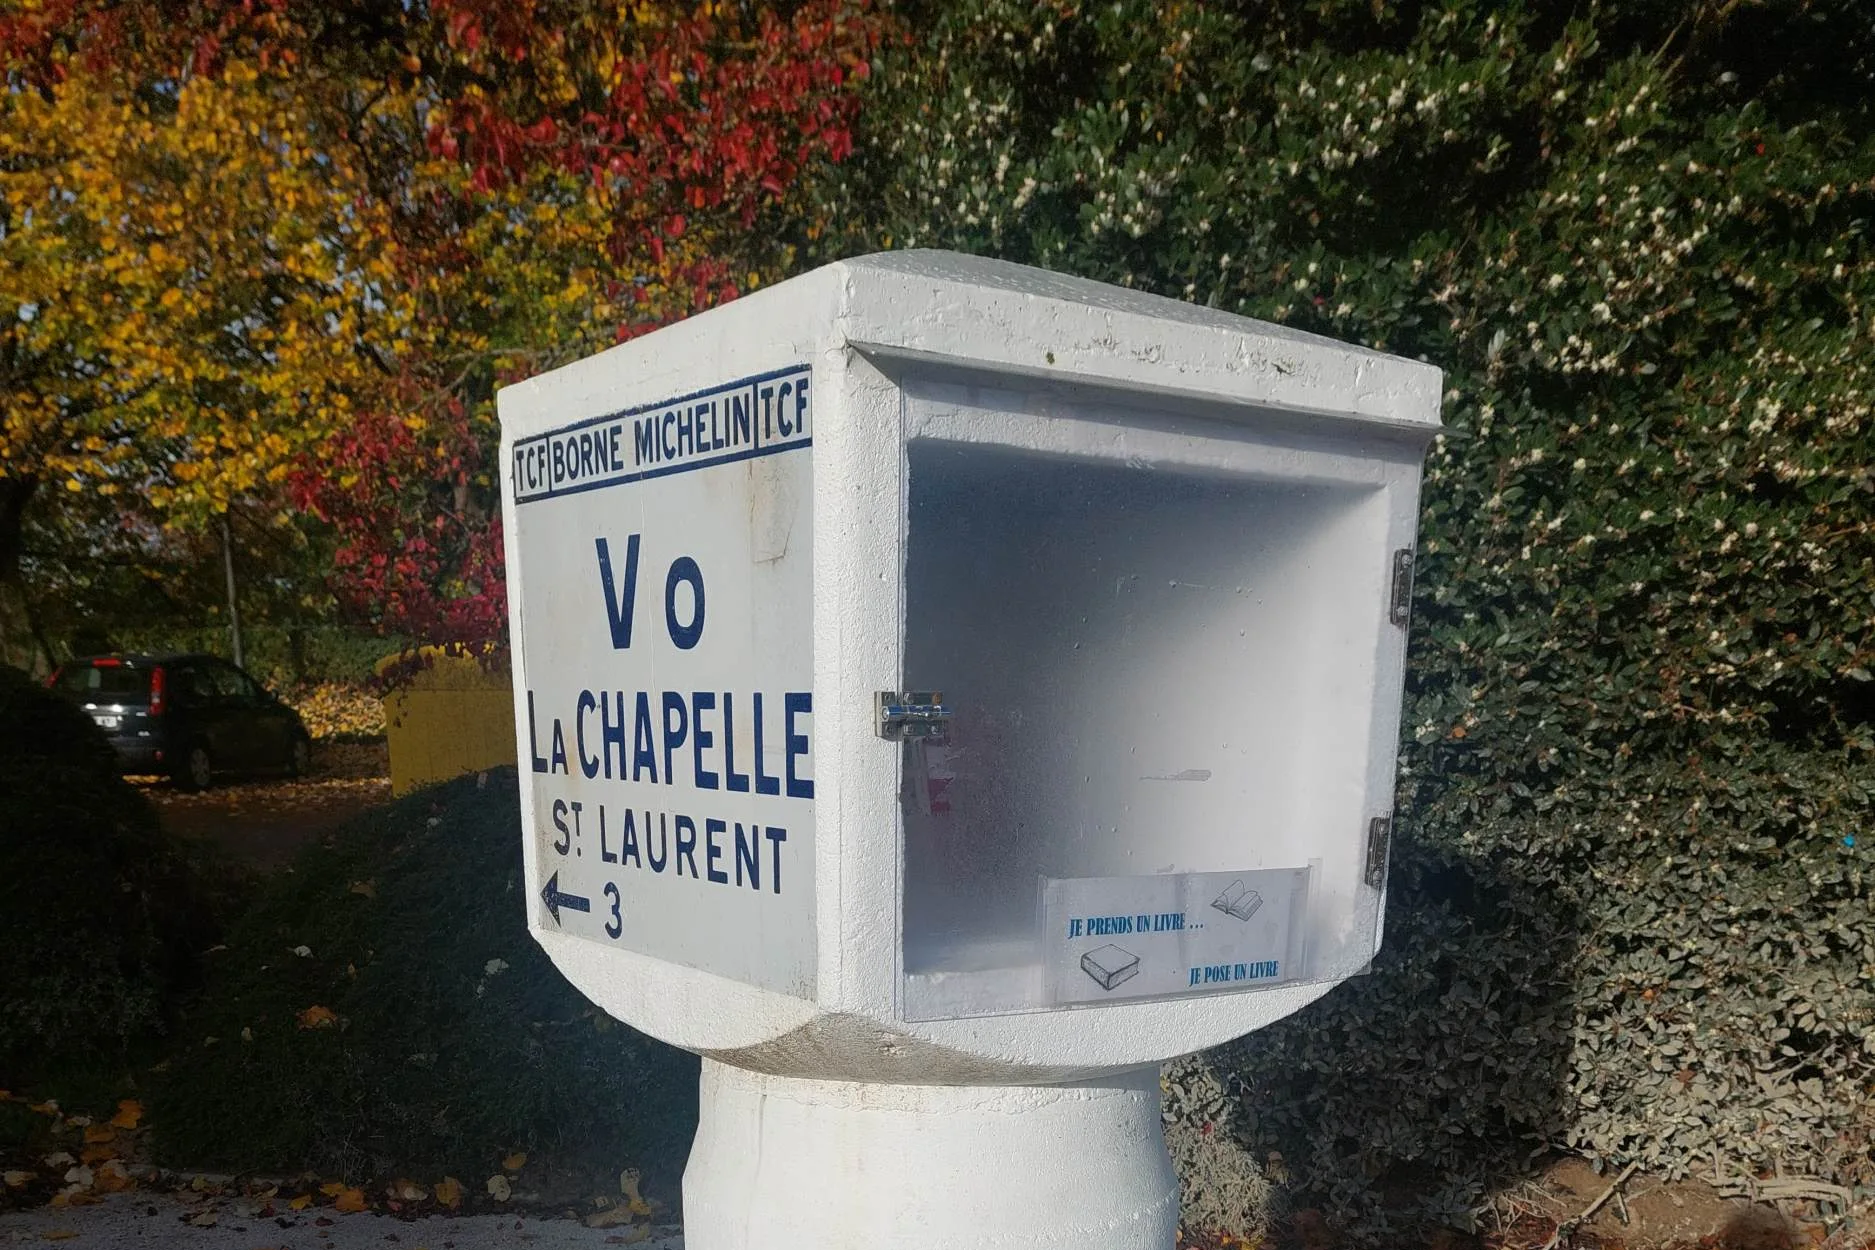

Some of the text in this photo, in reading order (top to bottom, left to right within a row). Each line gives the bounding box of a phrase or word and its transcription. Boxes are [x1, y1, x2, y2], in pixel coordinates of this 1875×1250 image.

[515, 378, 809, 492] TCF BORNE MICHELIN TCF
[577, 689, 814, 799] CHAPELLE
[600, 805, 787, 894] LAURENT
[603, 881, 623, 939] 3
[1068, 919, 1083, 939] JE
[1086, 916, 1133, 936] PRENDS
[1136, 915, 1151, 932] UN
[1154, 913, 1186, 931] LIVRE
[1189, 960, 1279, 987] JE POSE UN LIVRE
